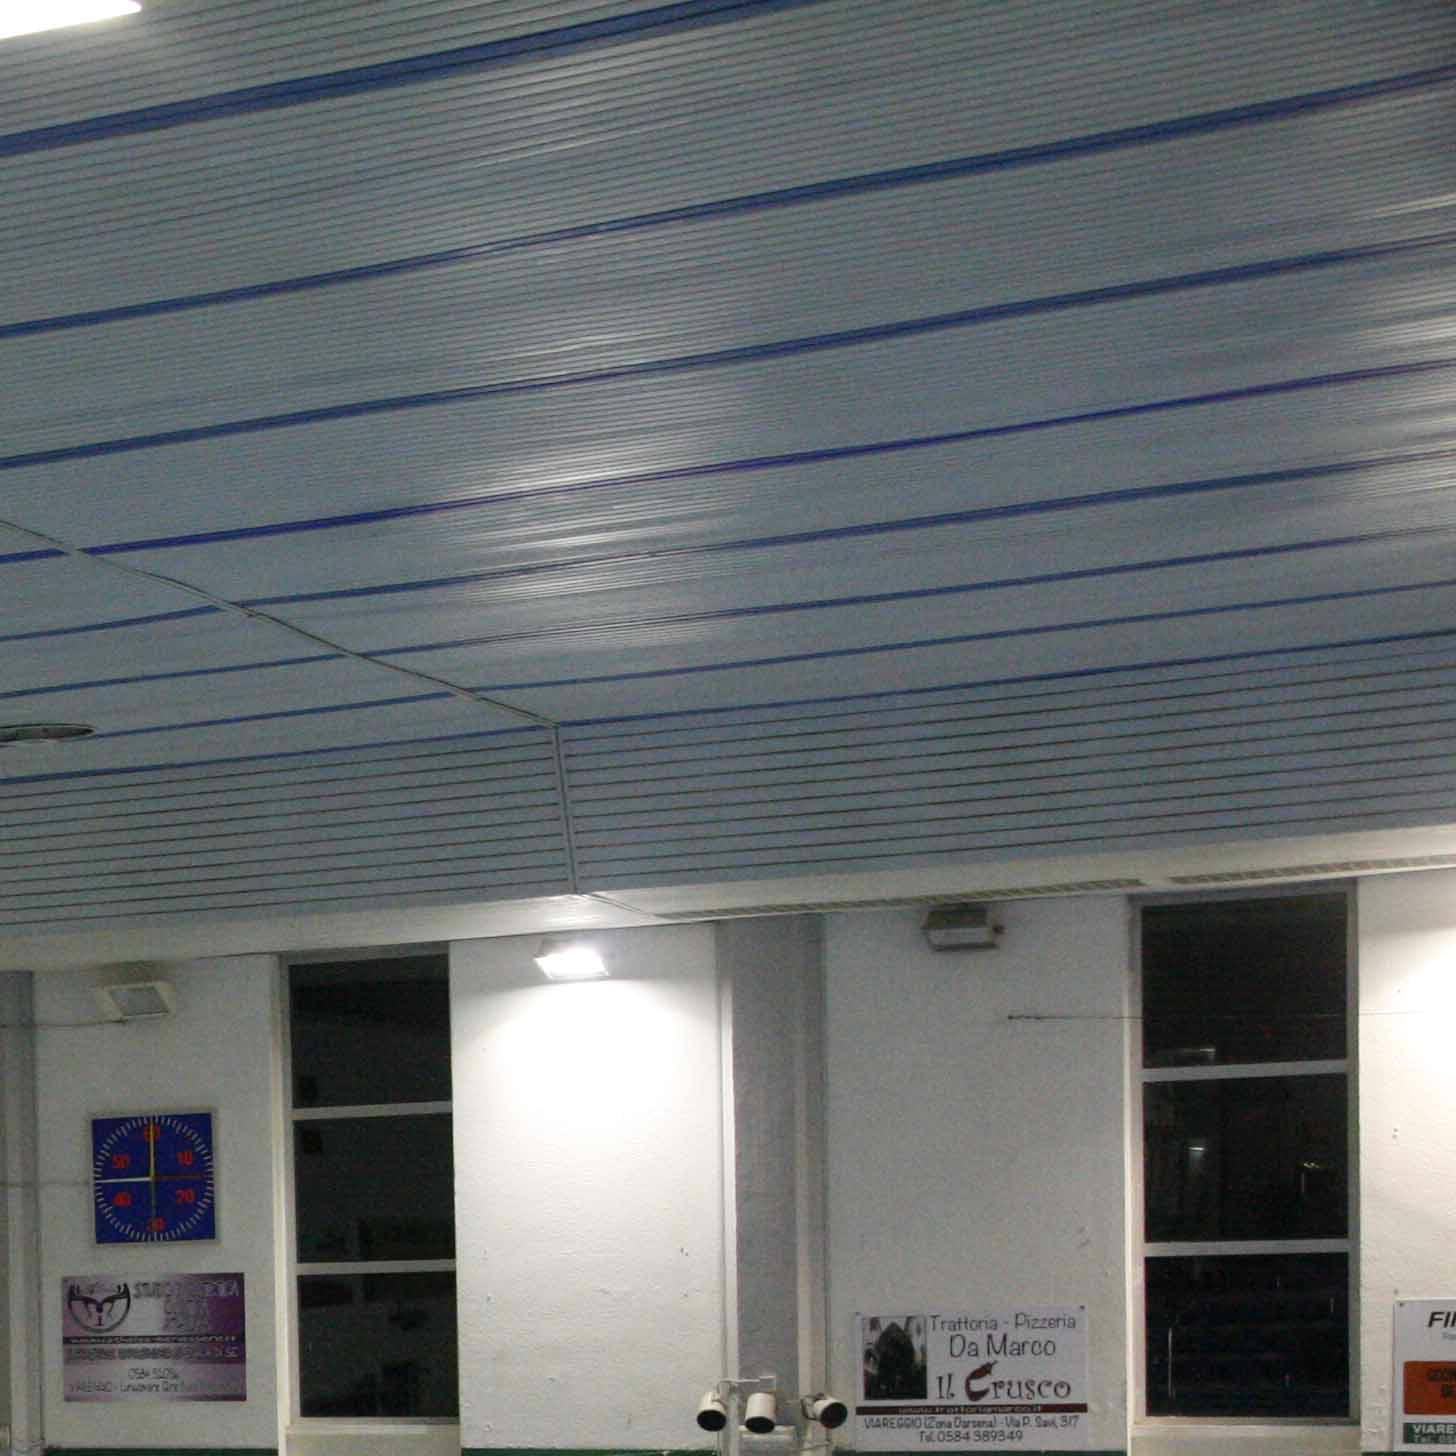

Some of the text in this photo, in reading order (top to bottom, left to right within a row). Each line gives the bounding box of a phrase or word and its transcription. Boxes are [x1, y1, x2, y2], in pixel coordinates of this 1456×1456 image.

[930, 1314, 999, 1332] Trattoria
[1014, 1312, 1077, 1329] Pizzeria
[949, 1332, 1056, 1358] Da Marco
[964, 1360, 1071, 1401] Crusco
[863, 1415, 922, 1429] VIAREGGIO
